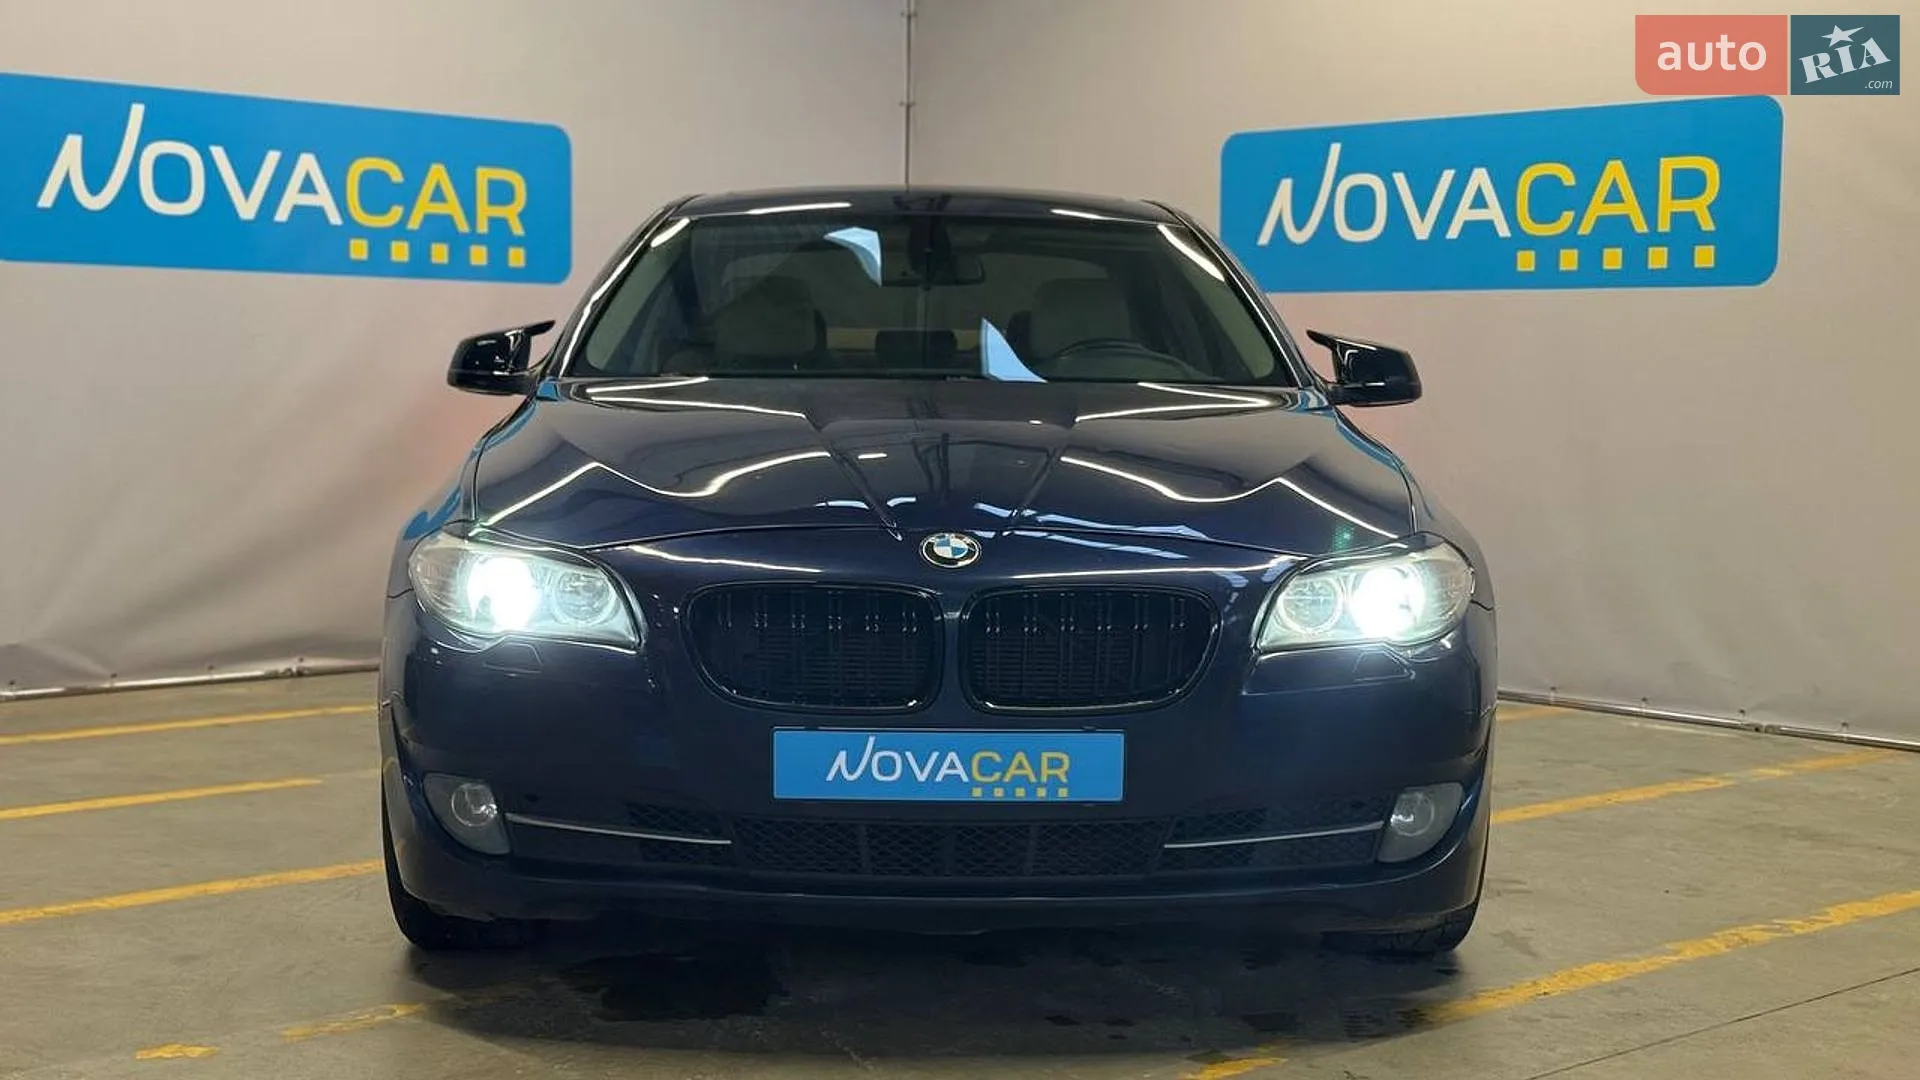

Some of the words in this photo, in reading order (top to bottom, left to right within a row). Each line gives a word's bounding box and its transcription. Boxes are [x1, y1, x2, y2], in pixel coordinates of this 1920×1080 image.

[37, 103, 527, 236] NOVACAR
[1257, 142, 1721, 247] NOVACAR
[825, 735, 1071, 784] NOVACAR
